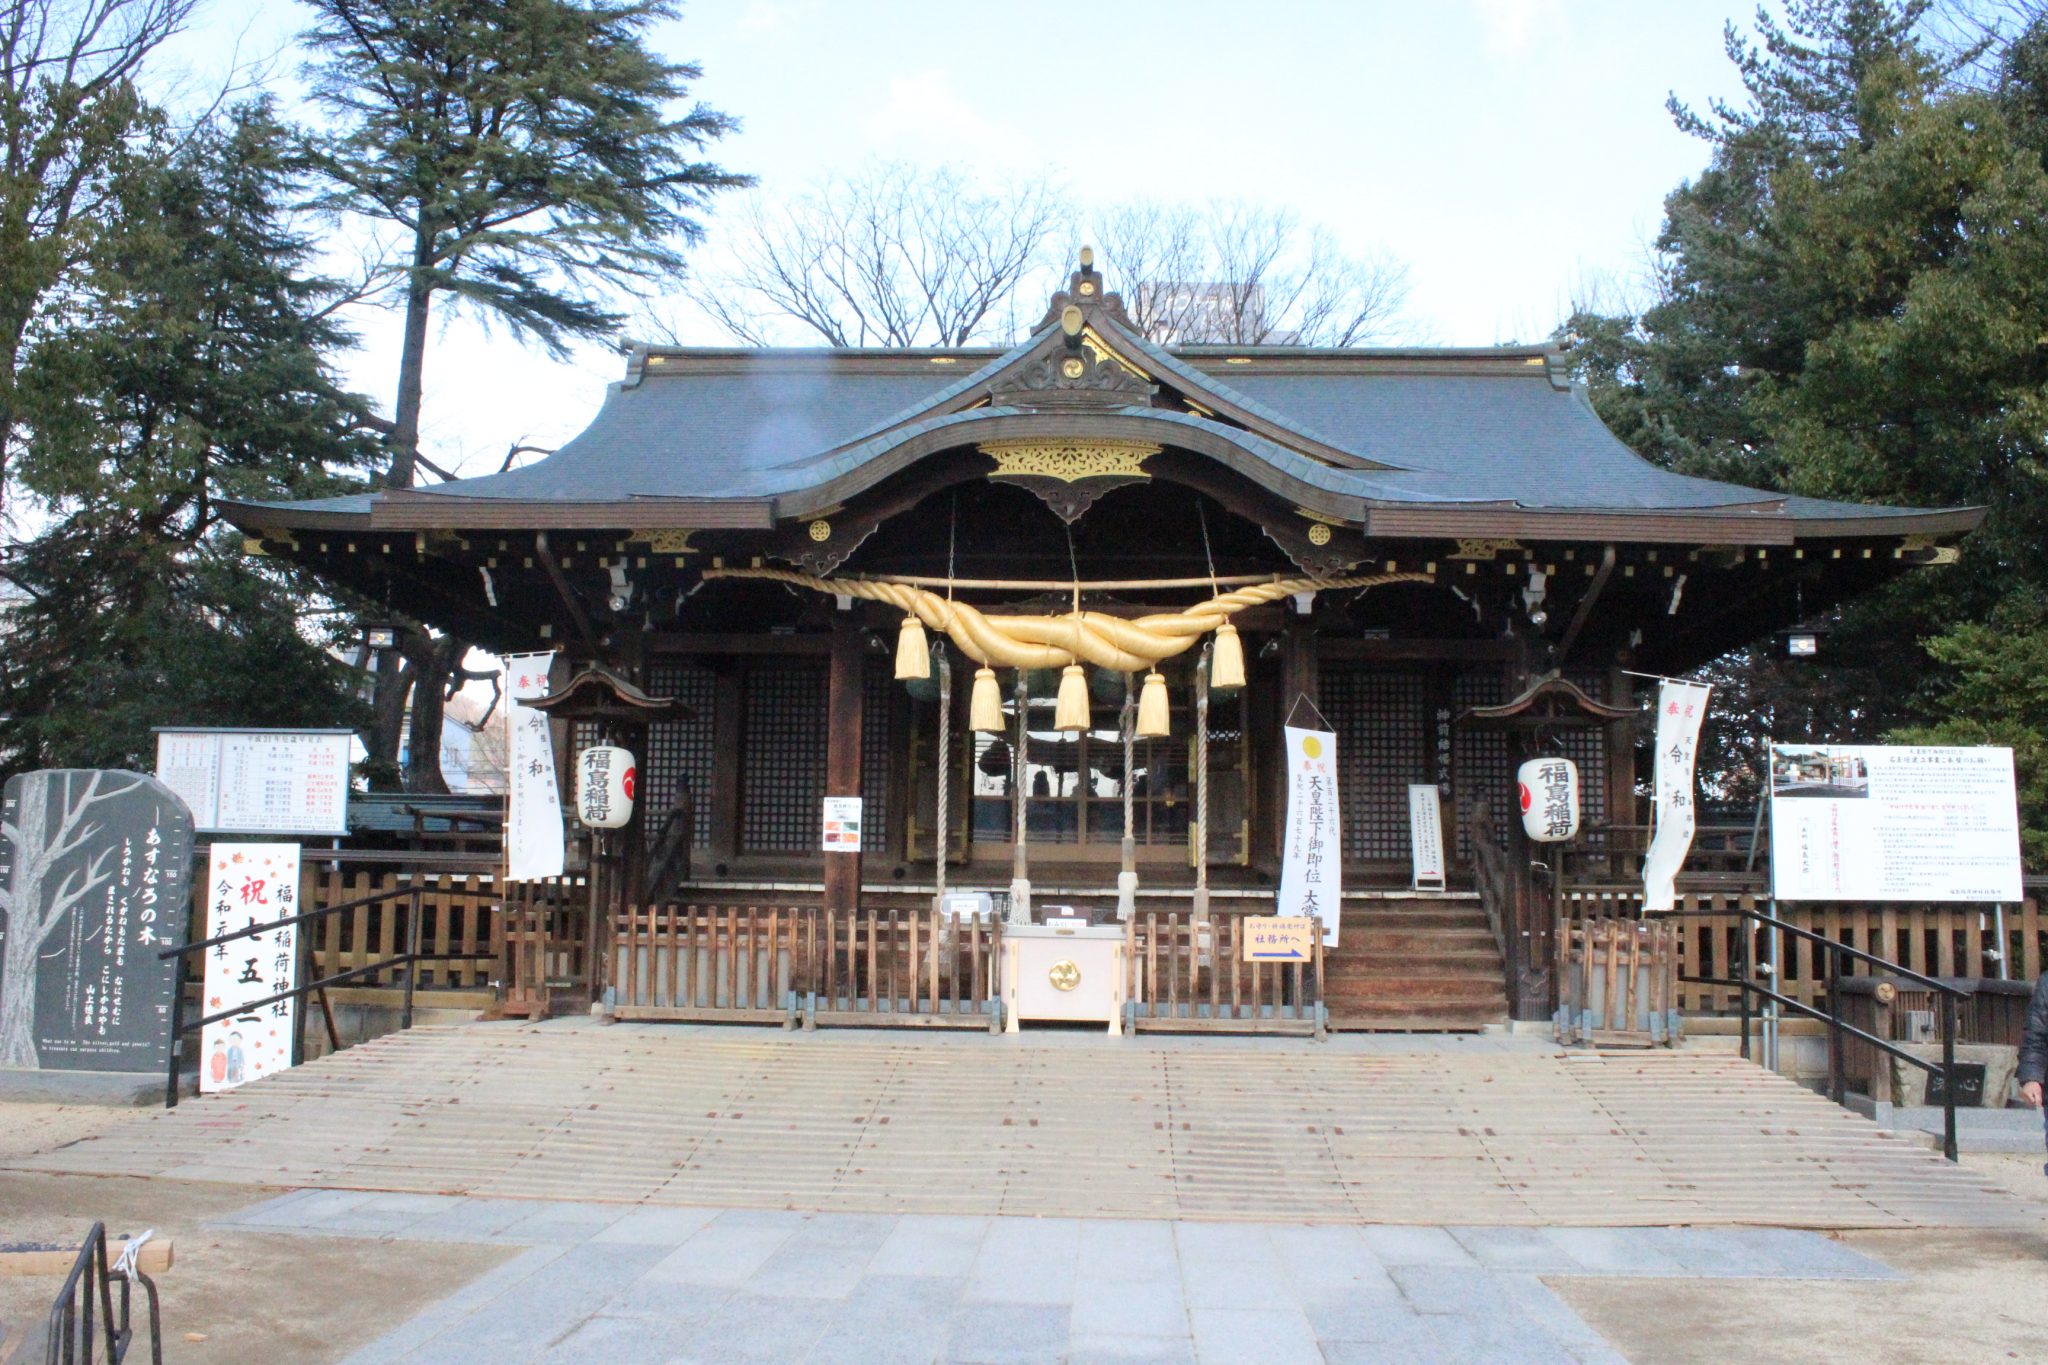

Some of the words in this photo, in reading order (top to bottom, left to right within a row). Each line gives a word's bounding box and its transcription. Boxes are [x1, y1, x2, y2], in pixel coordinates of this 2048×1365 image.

[517, 674, 548, 688] 奉祝
[1665, 701, 1695, 718] 奉祝
[527, 716, 545, 778] 令和
[1669, 744, 1686, 809] 令和
[584, 749, 612, 821] 福島稲荷
[1537, 762, 1572, 837] 福島稲荷
[1304, 775, 1325, 884] 天皇陛下御即位
[137, 827, 161, 946] あすなろの木
[213, 879, 233, 961] 令和元年
